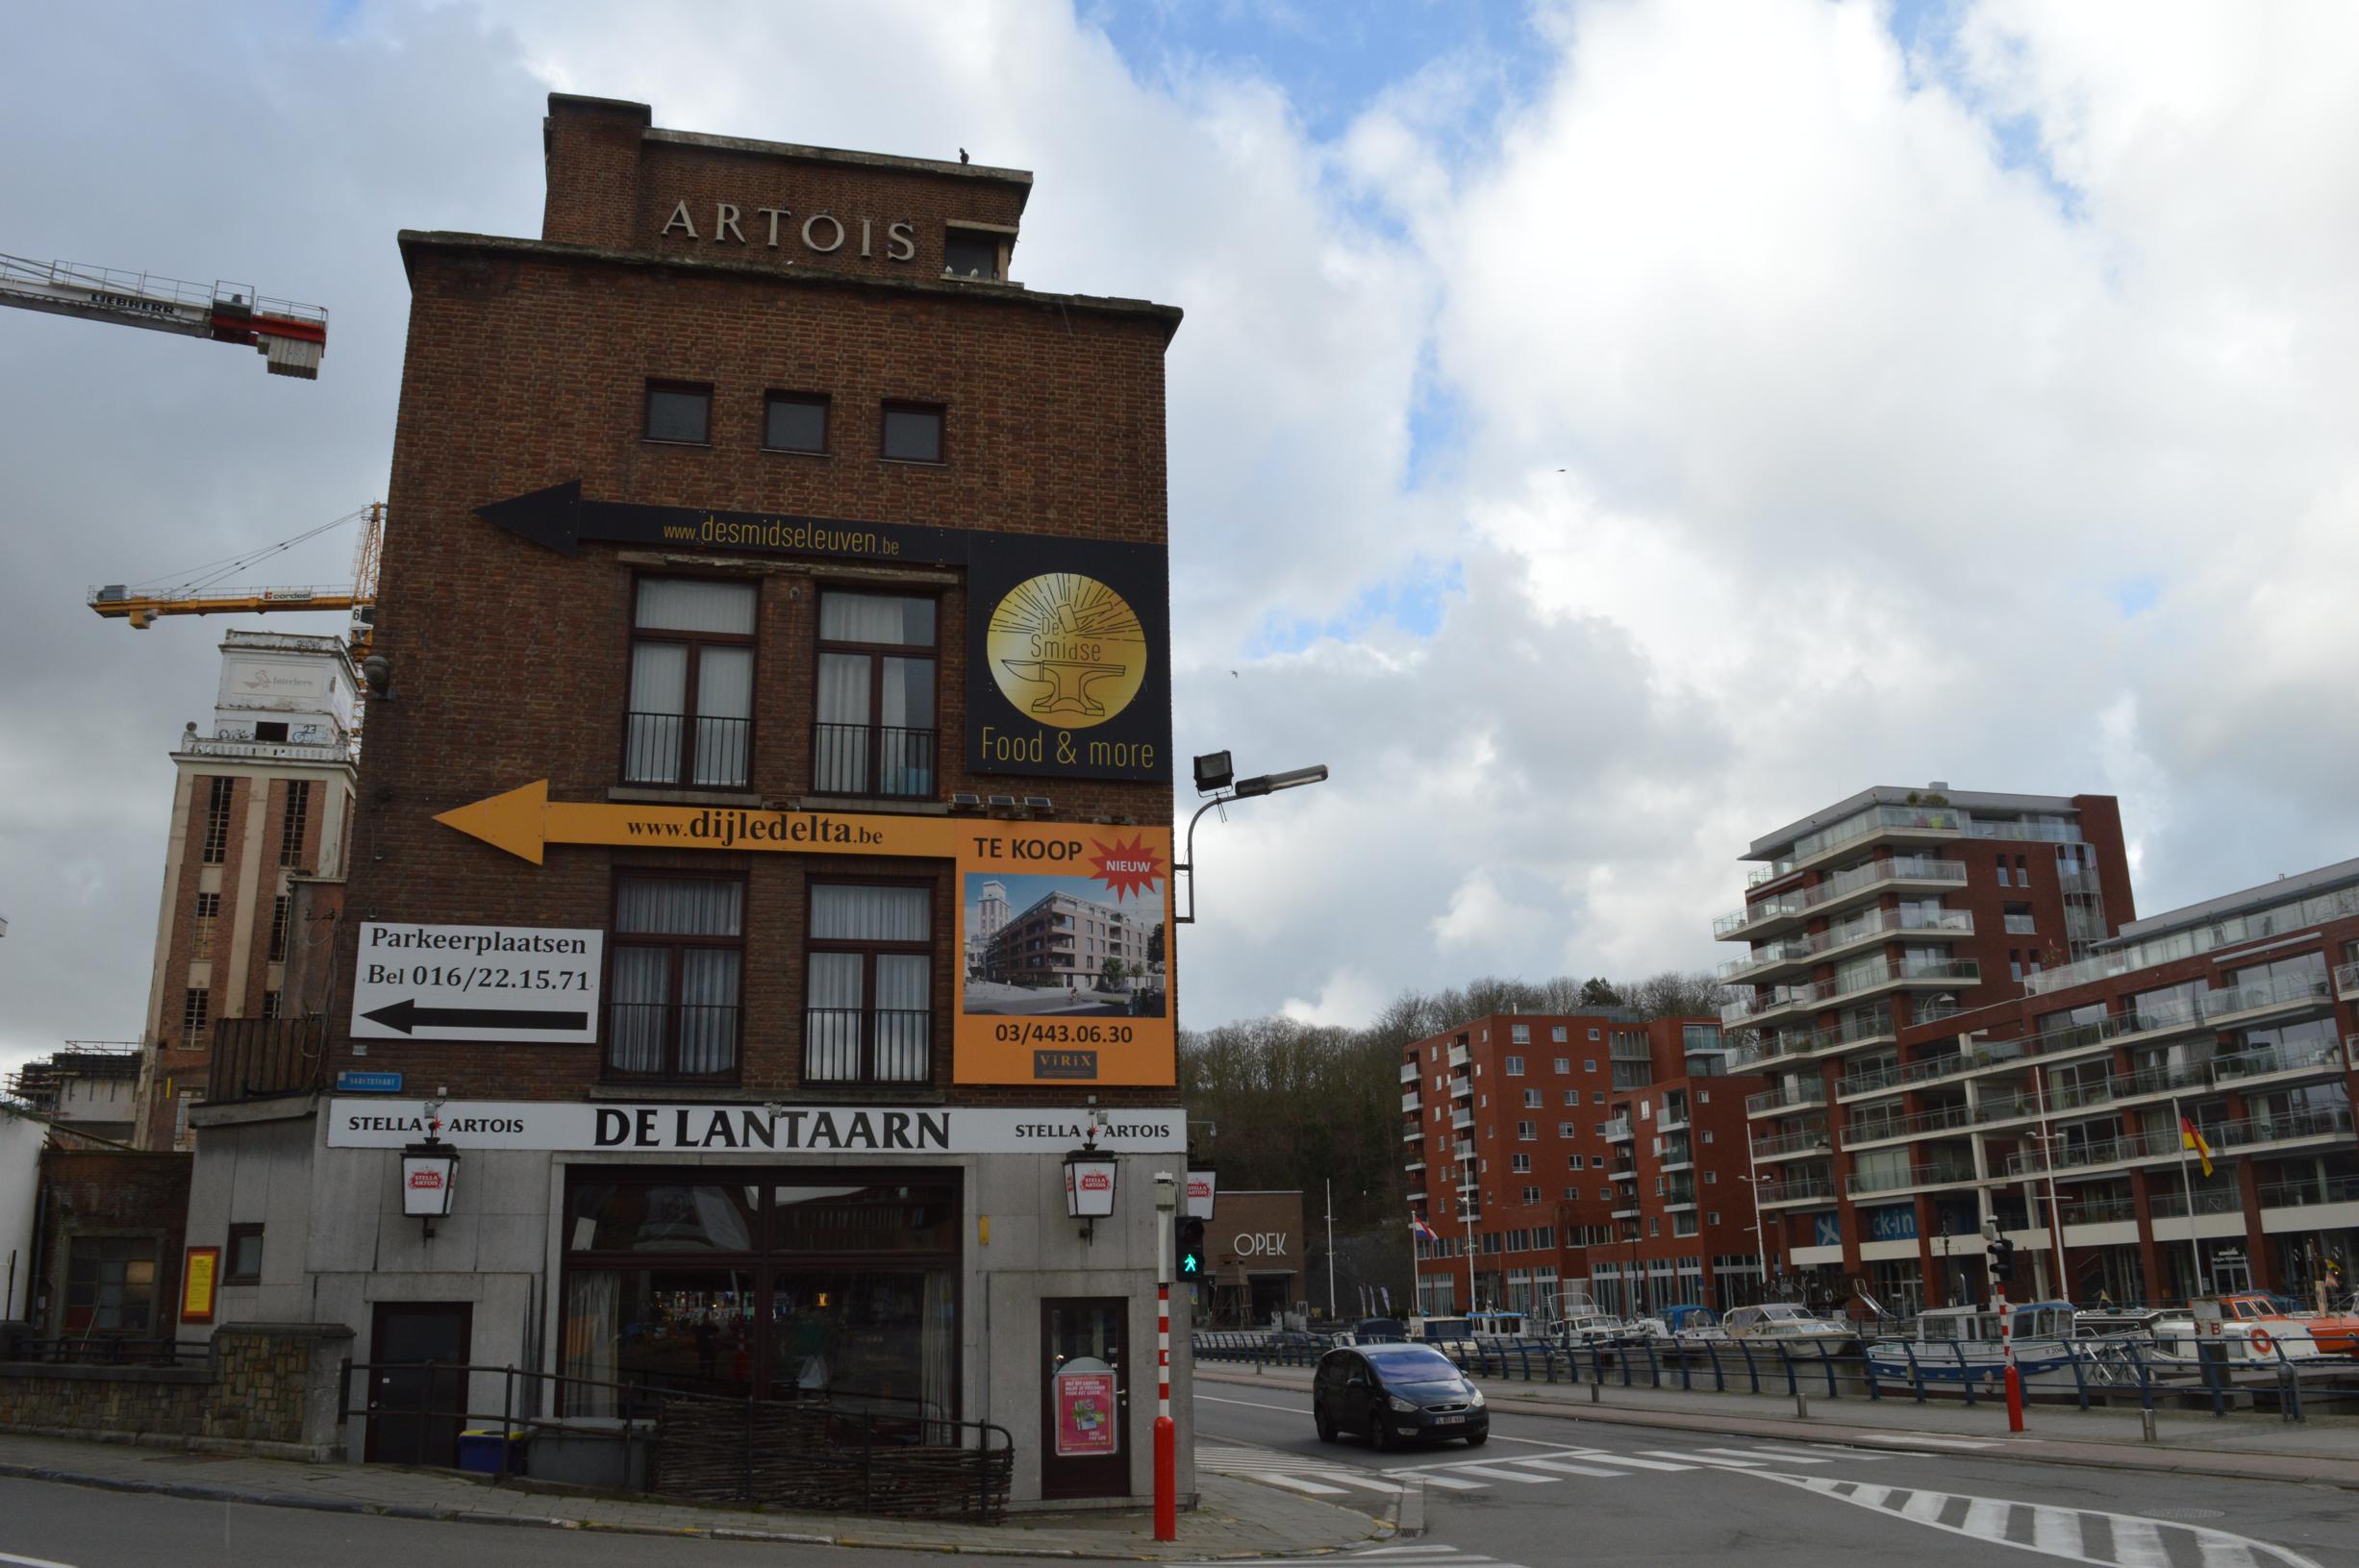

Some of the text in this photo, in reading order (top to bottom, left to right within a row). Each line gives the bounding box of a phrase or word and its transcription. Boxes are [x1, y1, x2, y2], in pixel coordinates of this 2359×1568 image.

[660, 199, 915, 261] ARTOIS
[91, 292, 174, 314] LIEBHERR
[664, 515, 900, 555] www.desmidseleuven.be
[353, 609, 361, 621] 6
[1041, 616, 1059, 635] De
[1031, 634, 1101, 661] Smidse
[982, 727, 1154, 768] Food & more
[627, 810, 884, 846] www.dijledelta.be
[973, 837, 1083, 861] TE KOOP
[1106, 859, 1151, 874] NIEUW
[370, 927, 587, 956] Parkeerplaatsen
[366, 964, 590, 992] Bel 016/22.15.71
[995, 1023, 1134, 1046] 03/443.06.30
[348, 1116, 524, 1133] STELLA ARTOIS
[594, 1108, 951, 1150] DE LANTAARN
[1016, 1124, 1170, 1138] STELLA ARTOIS
[1234, 1232, 1287, 1256] OPEK
[2211, 1322, 2221, 1335] B
